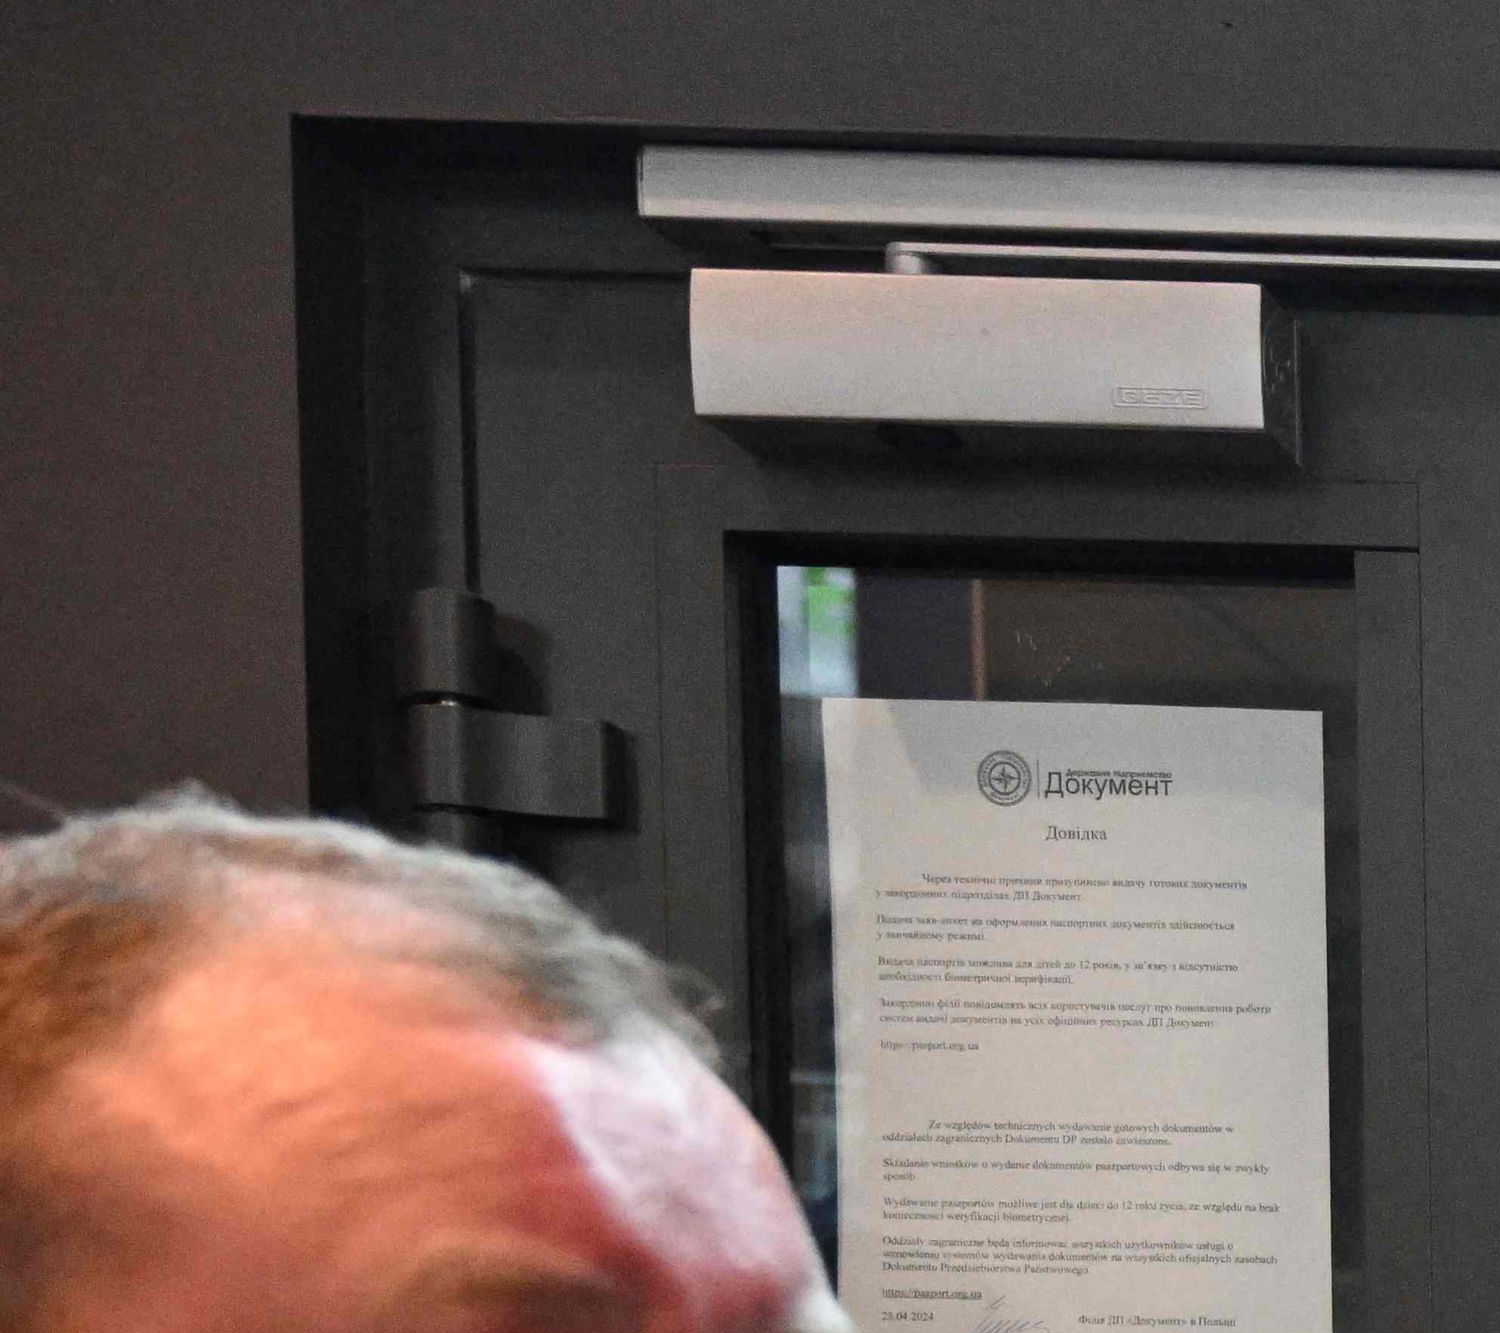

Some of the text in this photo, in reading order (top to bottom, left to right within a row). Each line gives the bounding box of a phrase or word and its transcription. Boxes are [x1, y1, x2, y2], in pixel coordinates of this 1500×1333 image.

[1045, 771, 1173, 800] Документ
[1045, 825, 1107, 841] Довідка
[1062, 1135, 1077, 1144] DP
